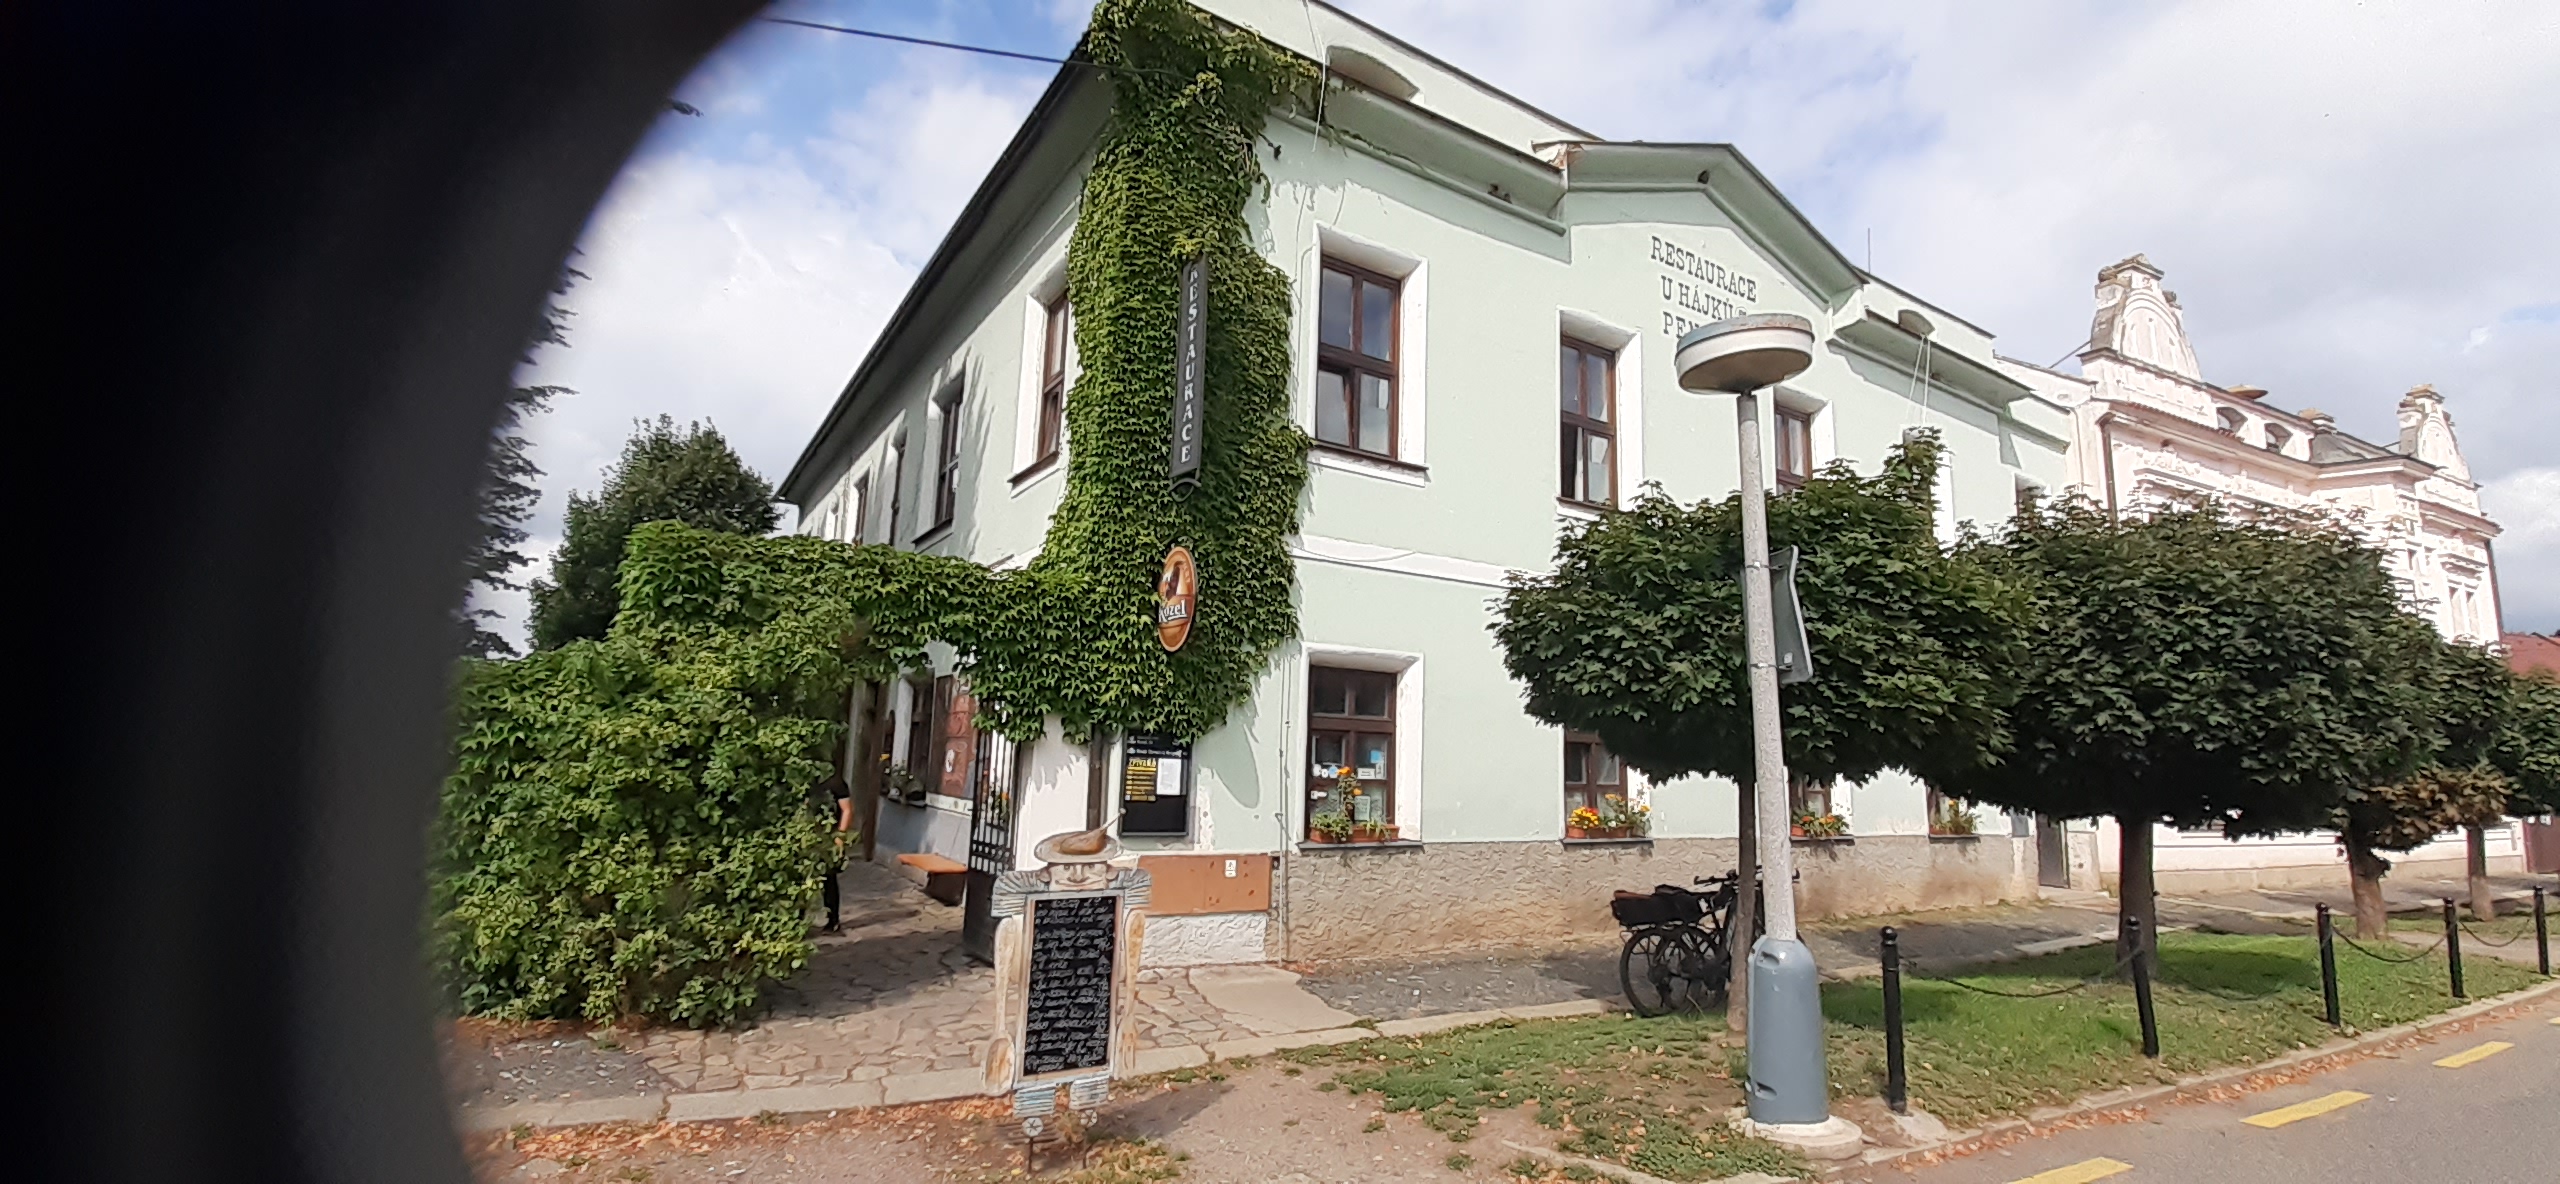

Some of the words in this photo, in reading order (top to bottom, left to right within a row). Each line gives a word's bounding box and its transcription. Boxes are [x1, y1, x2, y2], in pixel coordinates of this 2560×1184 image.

[1651, 235, 1757, 303] RESTAURACE
[1661, 275, 1673, 300] U
[1180, 266, 1199, 464] RESTAURACE
